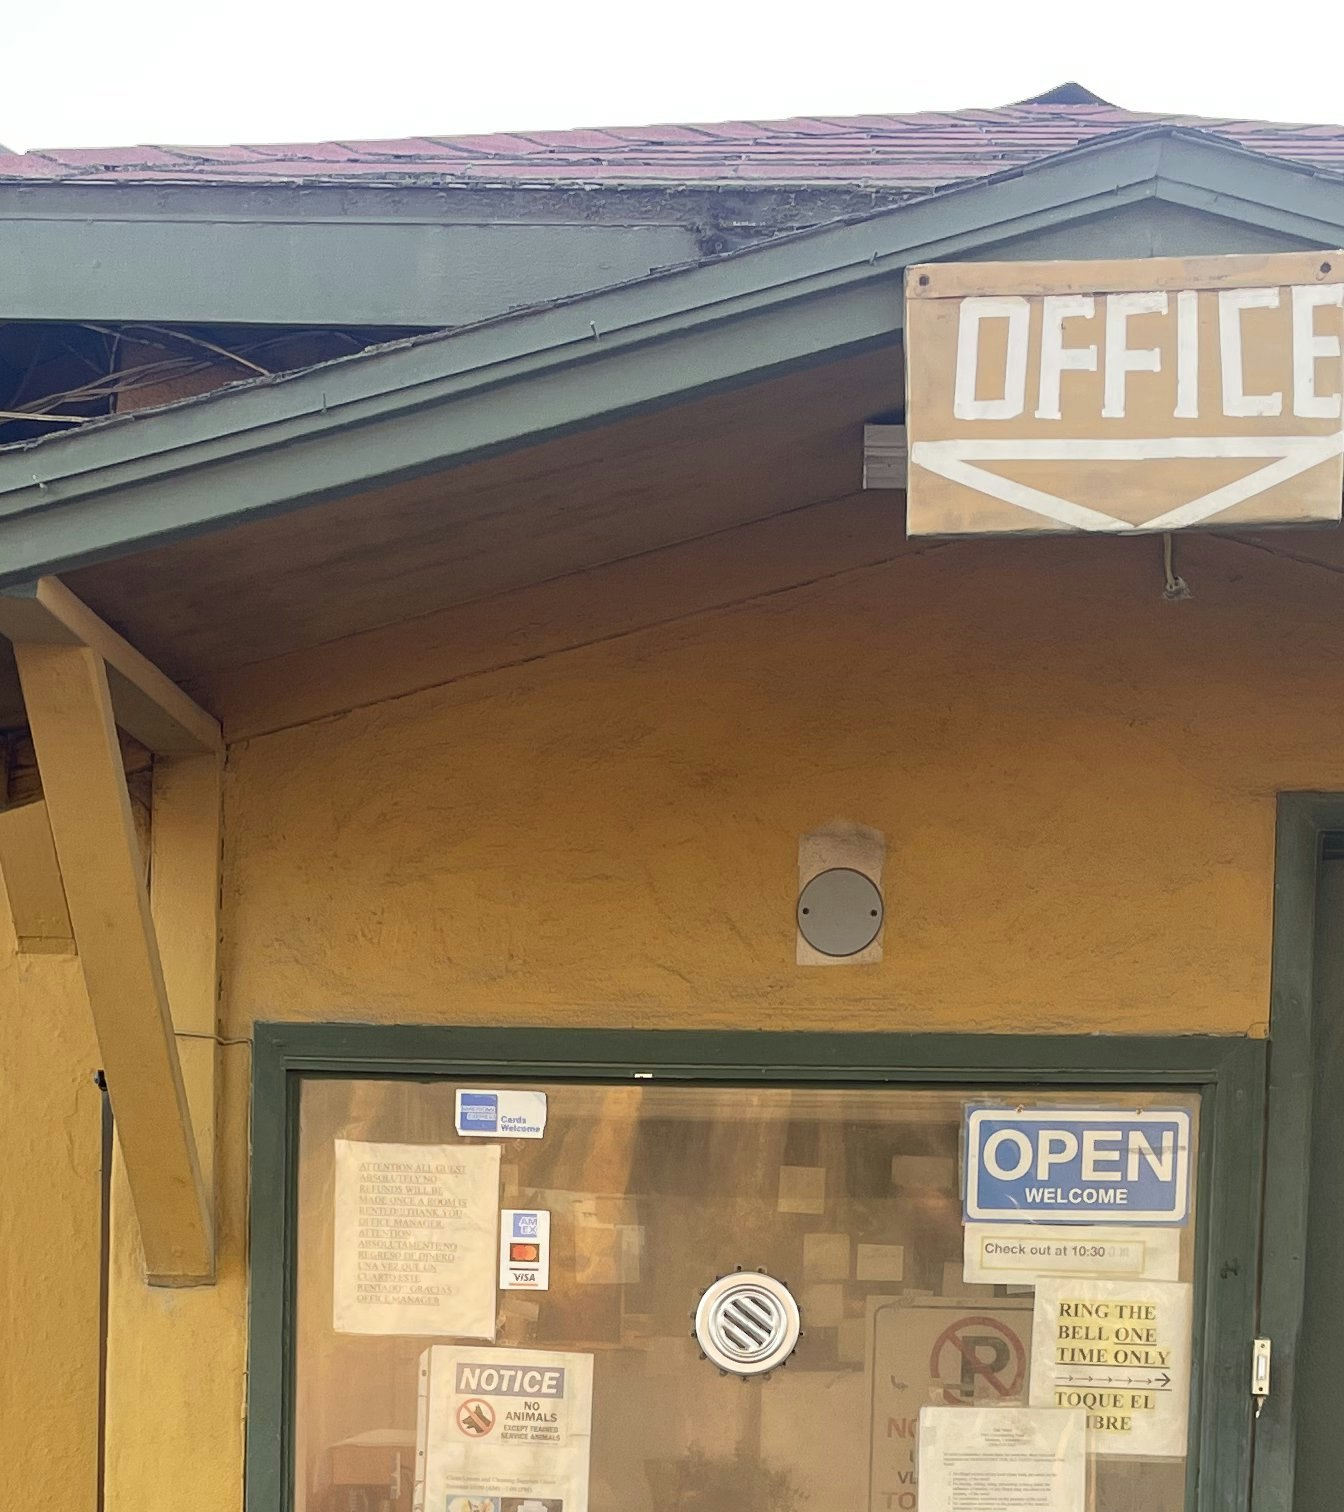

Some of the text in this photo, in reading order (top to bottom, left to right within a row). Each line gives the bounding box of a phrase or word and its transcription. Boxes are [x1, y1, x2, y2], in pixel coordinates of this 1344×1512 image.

[954, 284, 1344, 420] OFFICE
[501, 1115, 527, 1124] Cards
[501, 1124, 541, 1133] Welcome
[983, 1128, 1174, 1182] OPEN
[359, 1162, 413, 1173] ATTENTION
[416, 1163, 433, 1174] ALL
[424, 1174, 438, 1185] NO
[1025, 1187, 1128, 1204] WELCOME
[520, 1217, 538, 1226] AM
[522, 1226, 537, 1234] EX
[984, 1241, 1026, 1256] Check
[1030, 1244, 1050, 1256] out
[1054, 1245, 1067, 1257] at
[1071, 1245, 1106, 1258] 10:30
[513, 1272, 536, 1282] VISA
[1059, 1303, 1156, 1320] RING THE
[1058, 1325, 1157, 1343] BELL ONE
[1056, 1347, 1170, 1366] TIME ONLY
[459, 1367, 560, 1394] NOTICE
[523, 1400, 541, 1411] NO
[1055, 1391, 1156, 1410] TOQUE EL
[505, 1412, 558, 1423] ANIMALS
